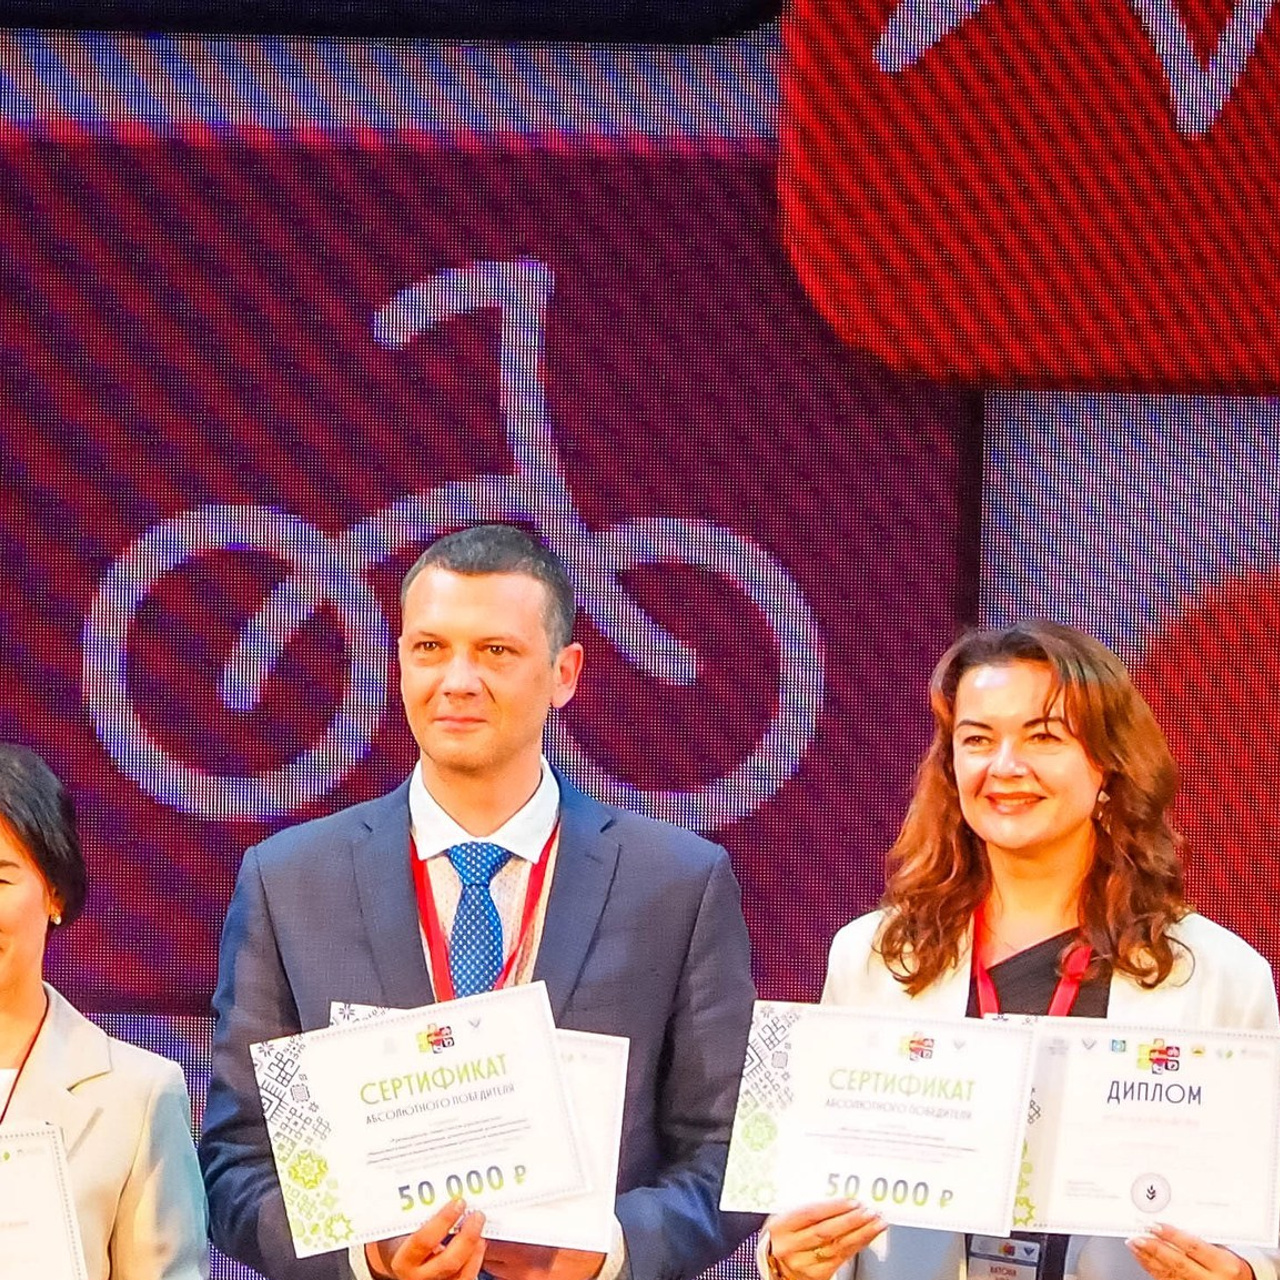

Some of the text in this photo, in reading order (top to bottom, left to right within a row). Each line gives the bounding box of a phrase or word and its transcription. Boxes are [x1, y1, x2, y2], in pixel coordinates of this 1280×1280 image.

[360, 1054, 507, 1106] СЕРТИФИКАТ
[828, 1067, 976, 1102] СЕРТИФИКАТ
[1107, 1079, 1202, 1106] ДИПЛОМ
[365, 1082, 515, 1126] АБСОЛЮТНОГО ПОБЕДИТЕЛЯ
[398, 1180, 435, 1211] 50
[446, 1165, 504, 1200] 000
[825, 1172, 860, 1200] 50
[871, 1177, 929, 1206] 000
